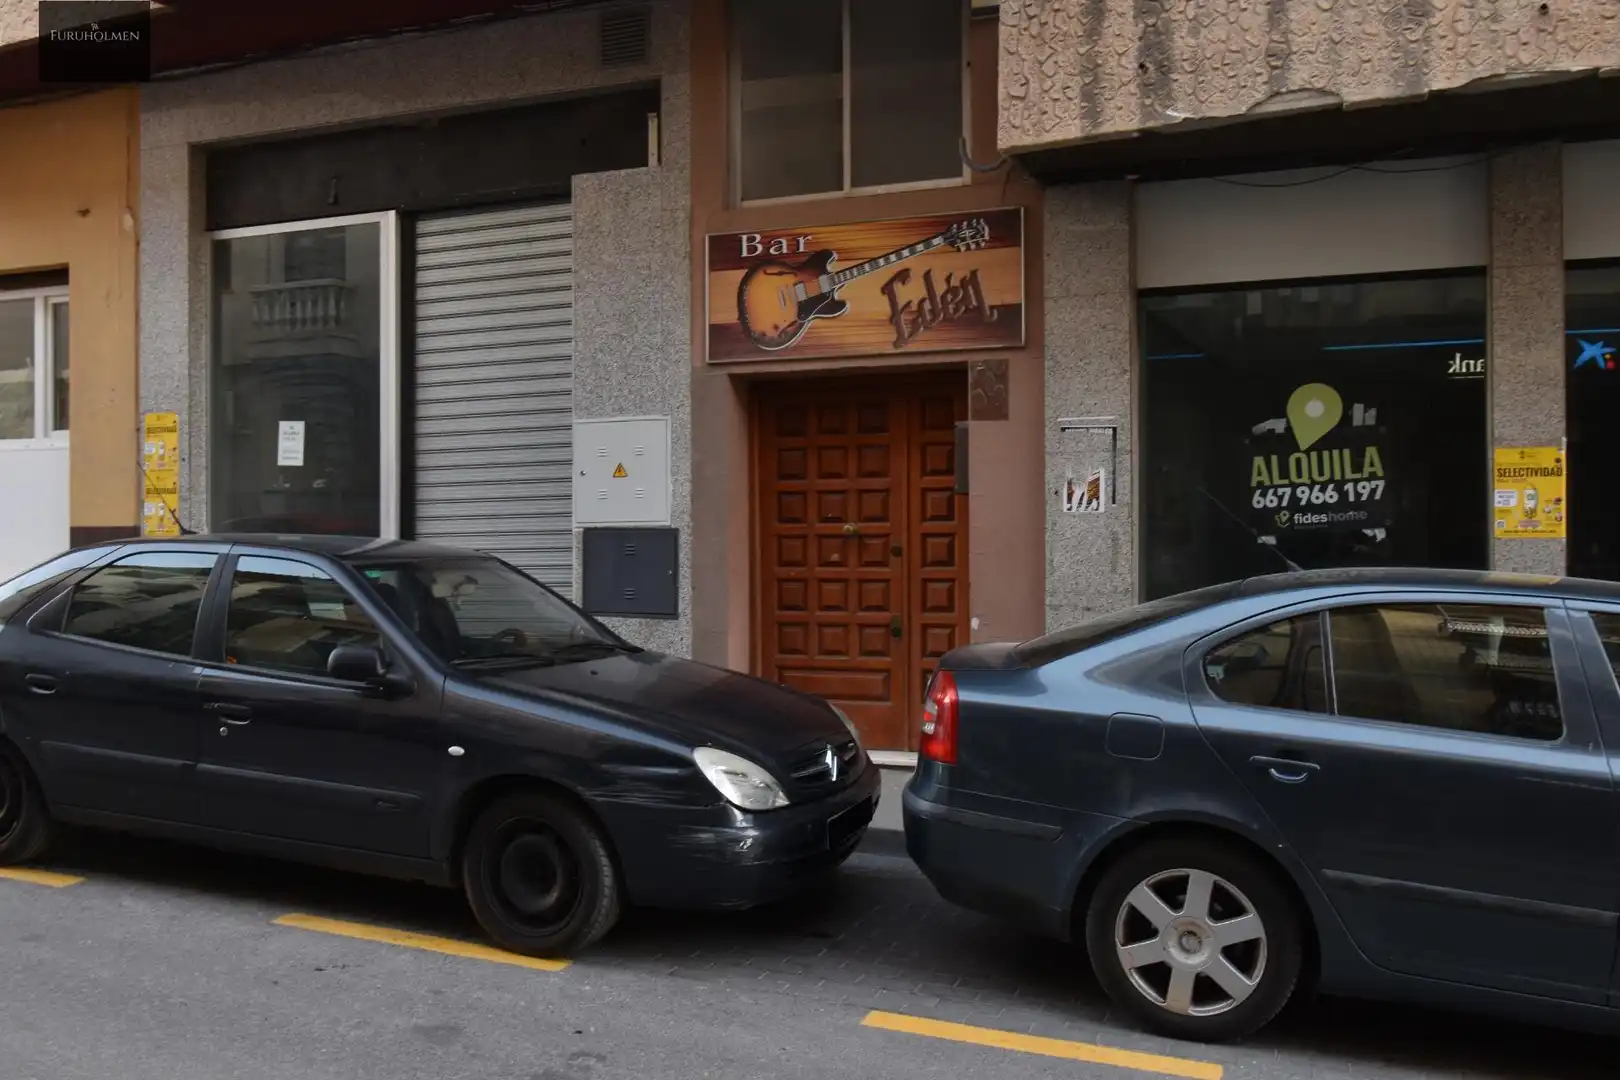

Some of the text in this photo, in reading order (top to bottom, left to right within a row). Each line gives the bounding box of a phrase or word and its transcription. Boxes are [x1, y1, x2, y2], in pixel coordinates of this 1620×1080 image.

[739, 233, 813, 258] Bar
[1250, 446, 1384, 487] ALQUILA
[1496, 467, 1563, 478] SELECTIVIDAD
[1251, 480, 1386, 509] 667 966 197
[1293, 510, 1368, 525] fideshome
